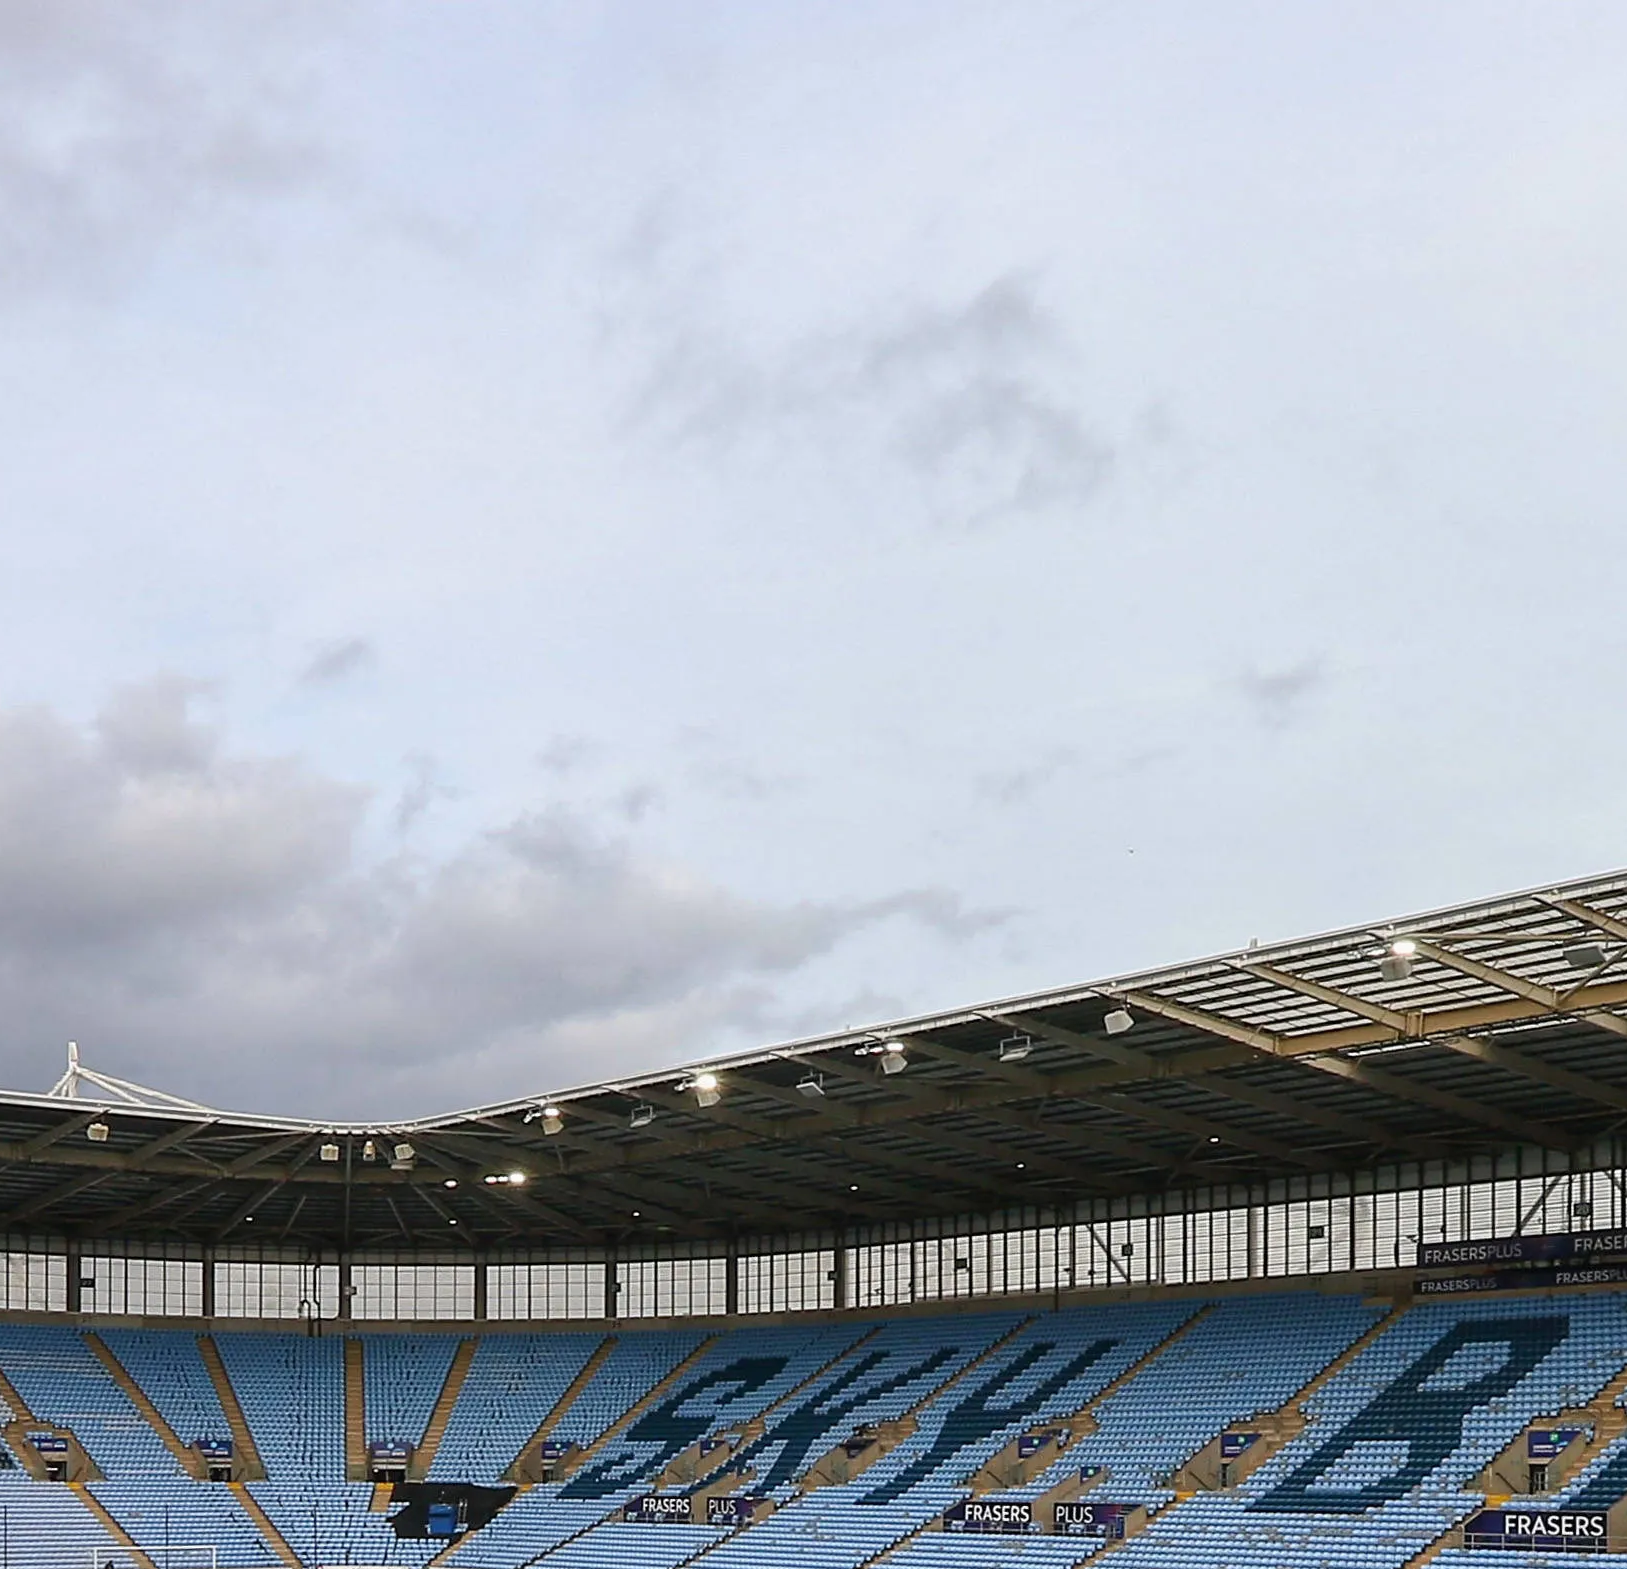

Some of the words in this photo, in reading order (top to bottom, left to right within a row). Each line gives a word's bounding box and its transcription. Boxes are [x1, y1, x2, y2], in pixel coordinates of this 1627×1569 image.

[557, 1339, 1120, 1503] SKY
[642, 1498, 690, 1513] FRASERS
[708, 1499, 736, 1514] PLUS
[965, 1504, 1030, 1522] FRASERS
[1056, 1506, 1093, 1523] PLUS
[1505, 1515, 1604, 1536] FRASERS
